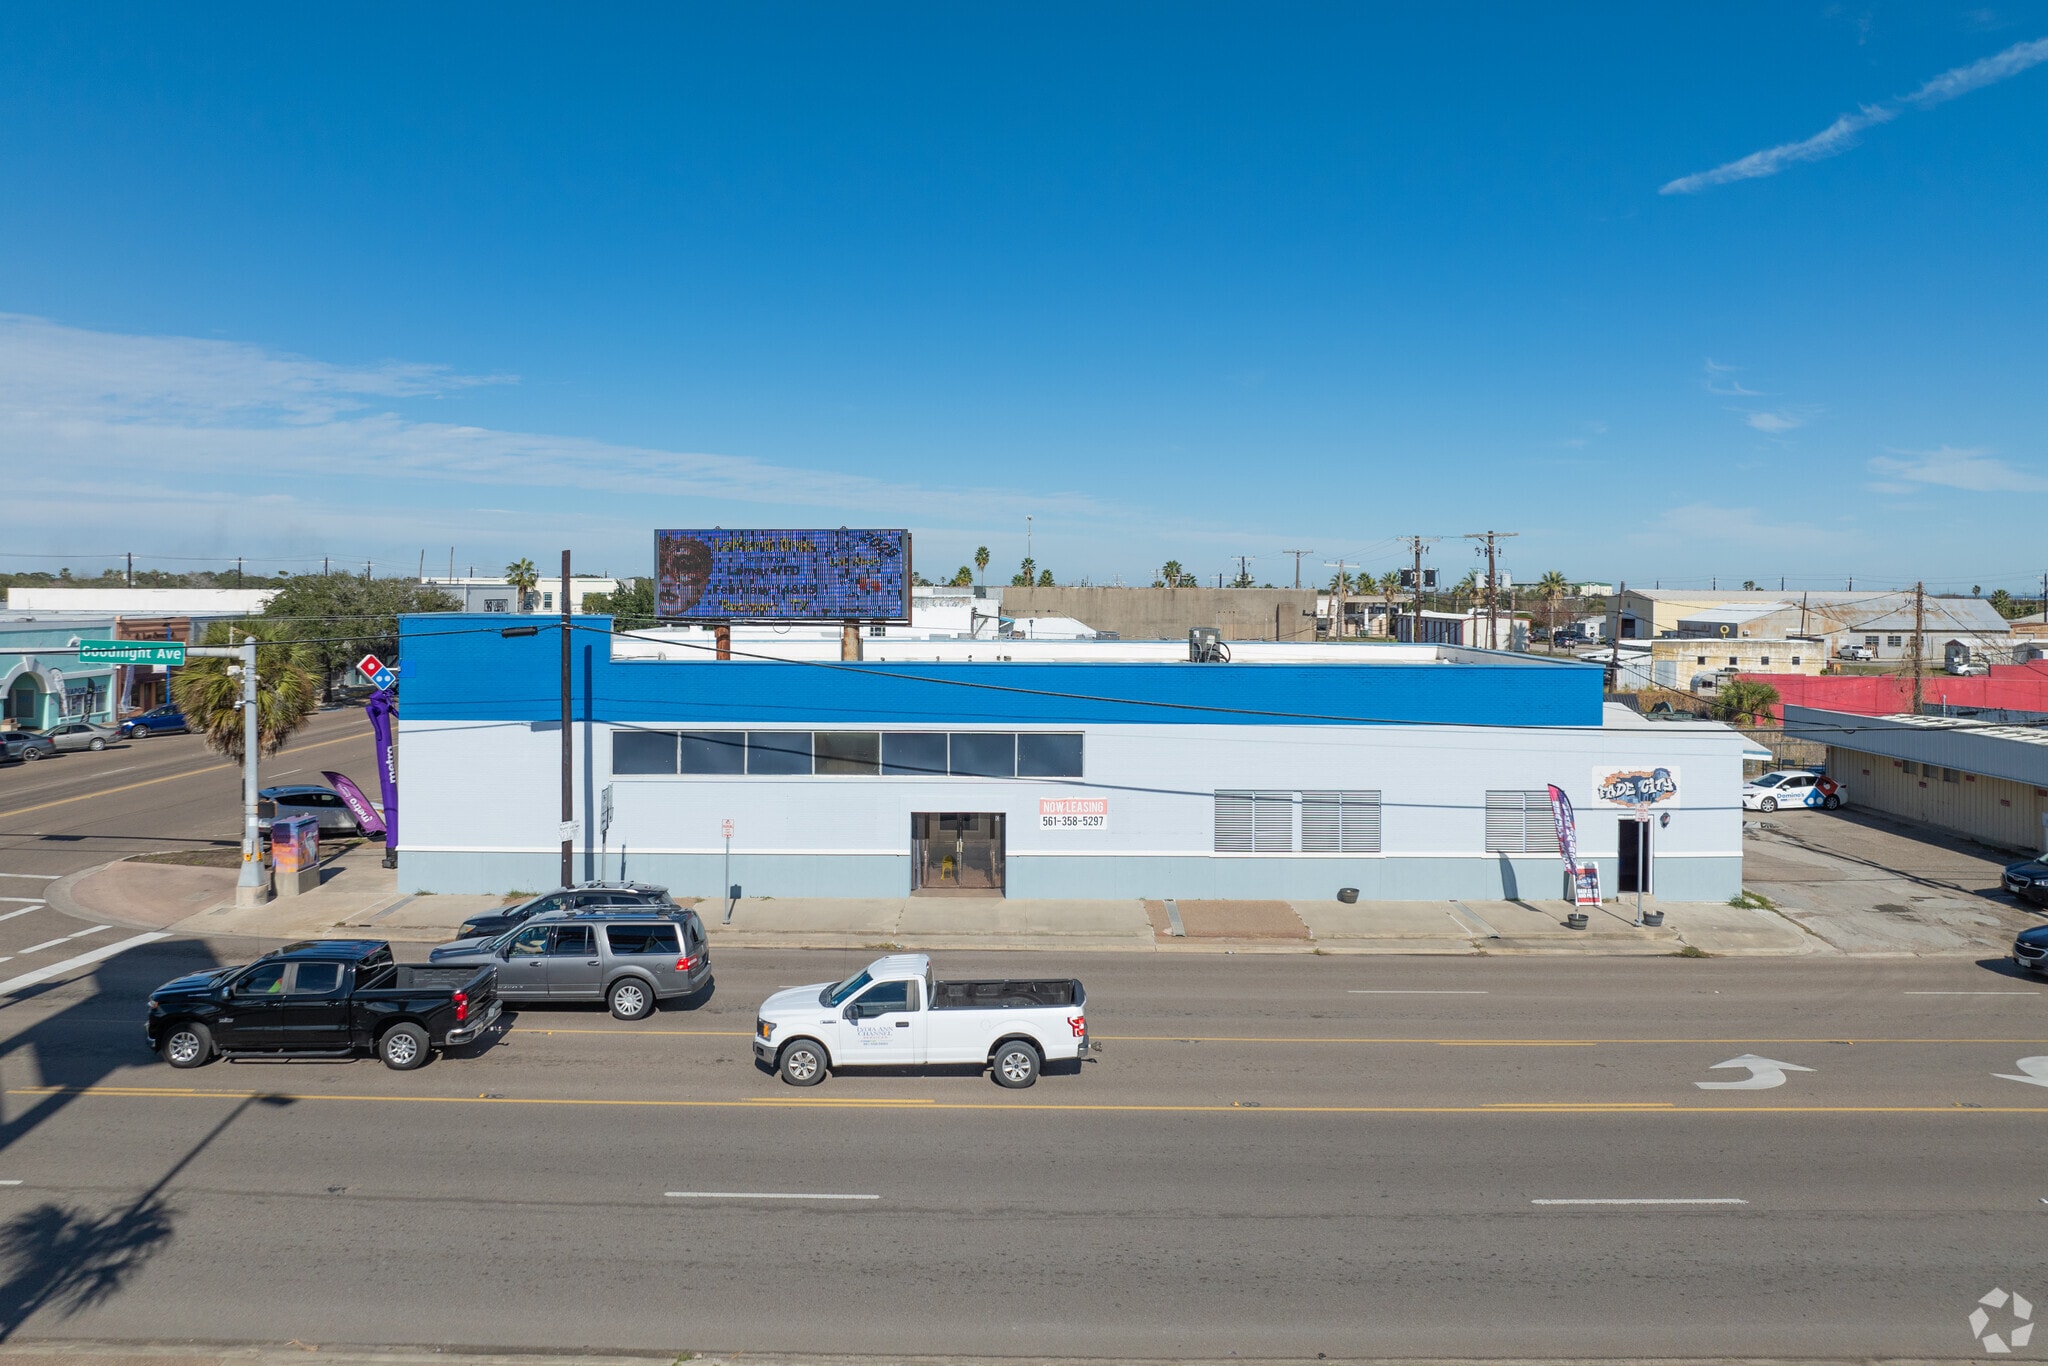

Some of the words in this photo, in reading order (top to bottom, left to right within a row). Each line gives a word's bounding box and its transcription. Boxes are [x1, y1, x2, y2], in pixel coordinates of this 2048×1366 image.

[712, 584, 770, 597] February
[82, 645, 152, 661] Goodnight
[156, 647, 182, 660] Ave
[1597, 781, 1637, 799] FADE
[349, 797, 373, 823] metro
[1043, 801, 1064, 813] NOW
[1066, 801, 1104, 813] LEASING
[1042, 816, 1104, 826] 561-358-5297
